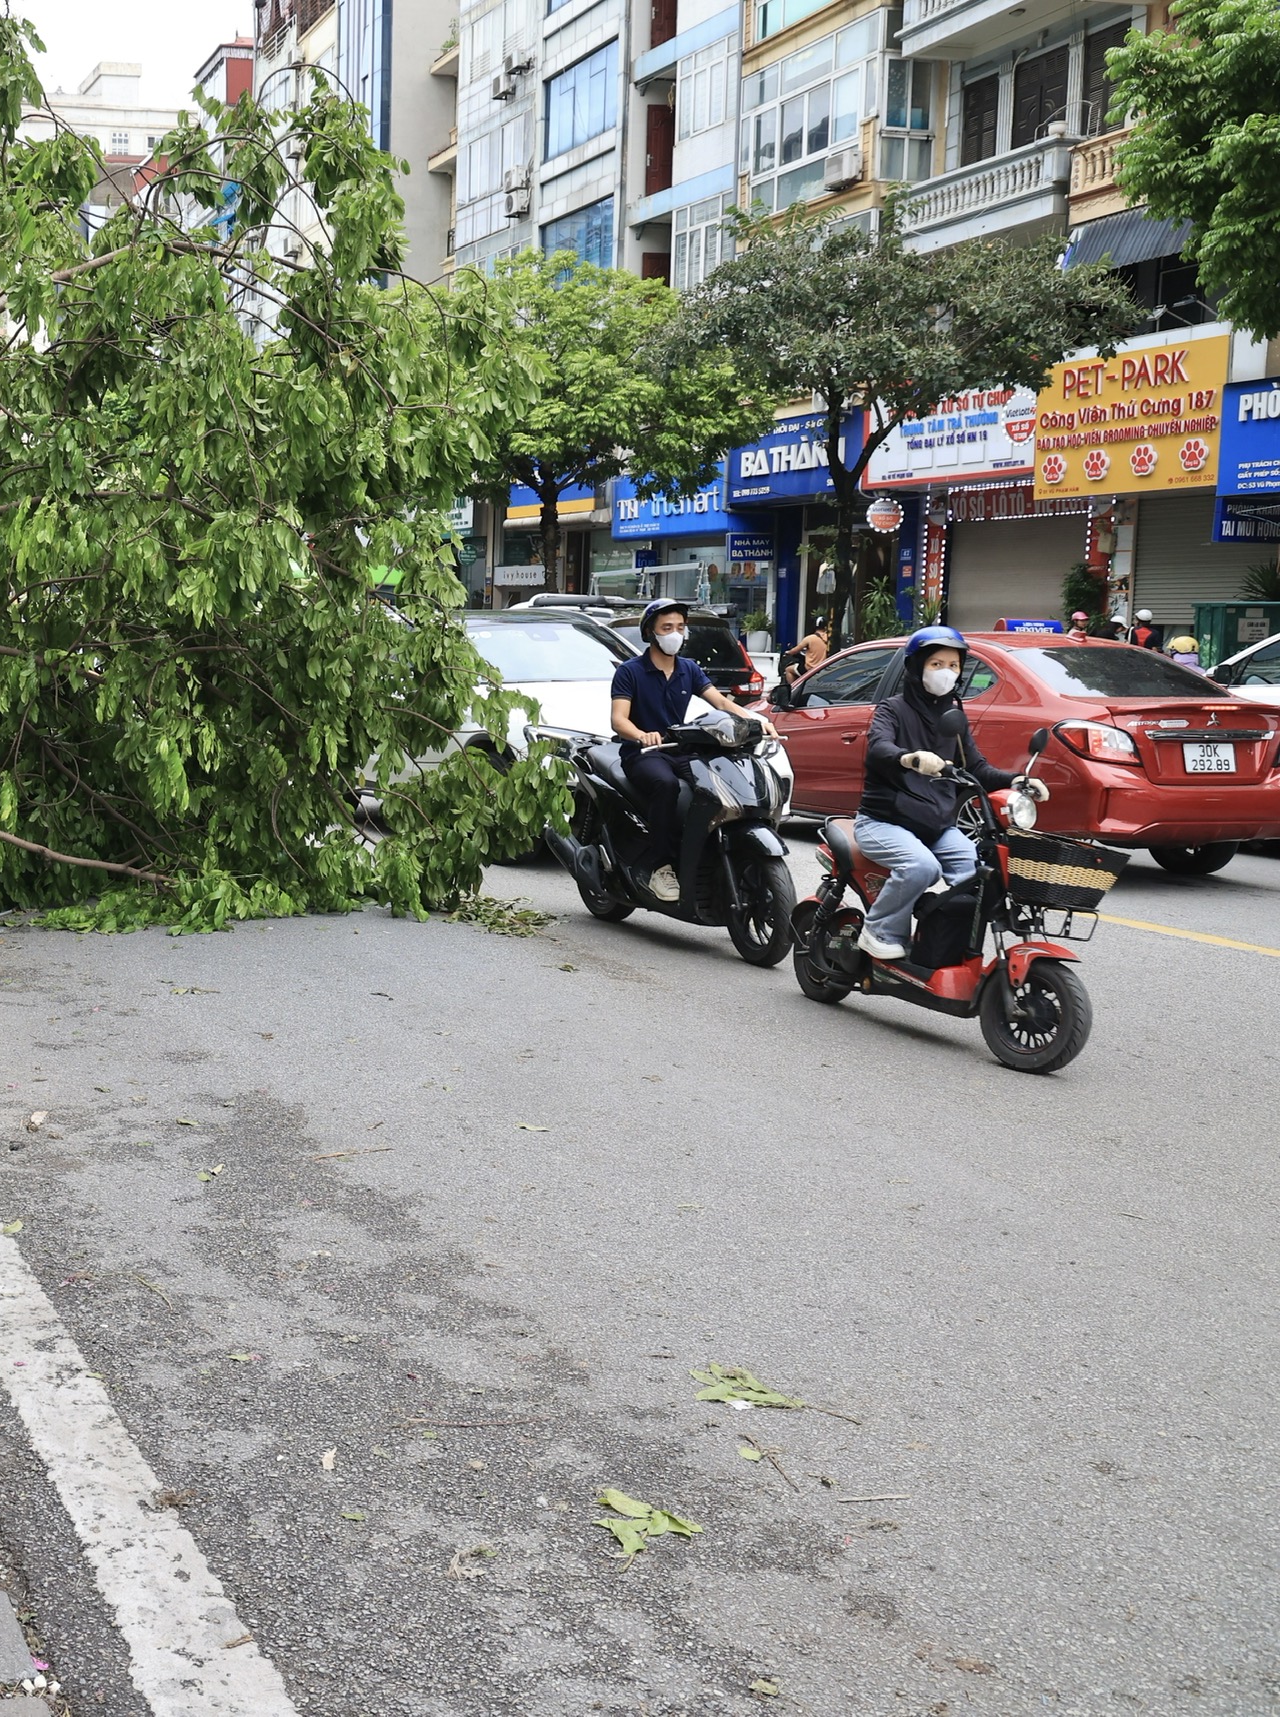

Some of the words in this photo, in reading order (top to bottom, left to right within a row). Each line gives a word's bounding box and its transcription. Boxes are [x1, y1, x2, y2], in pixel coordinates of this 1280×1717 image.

[1040, 409, 1077, 431] Công
[1079, 404, 1109, 425] Viên
[1111, 398, 1138, 421] Thú
[1140, 396, 1184, 418] Cưng
[1187, 389, 1217, 411] 187
[740, 449, 769, 478] BA
[1222, 520, 1235, 536] TAI
[734, 537, 750, 546] NHÀ
[1198, 744, 1220, 758] 30K
[1191, 759, 1230, 771] 292.89
